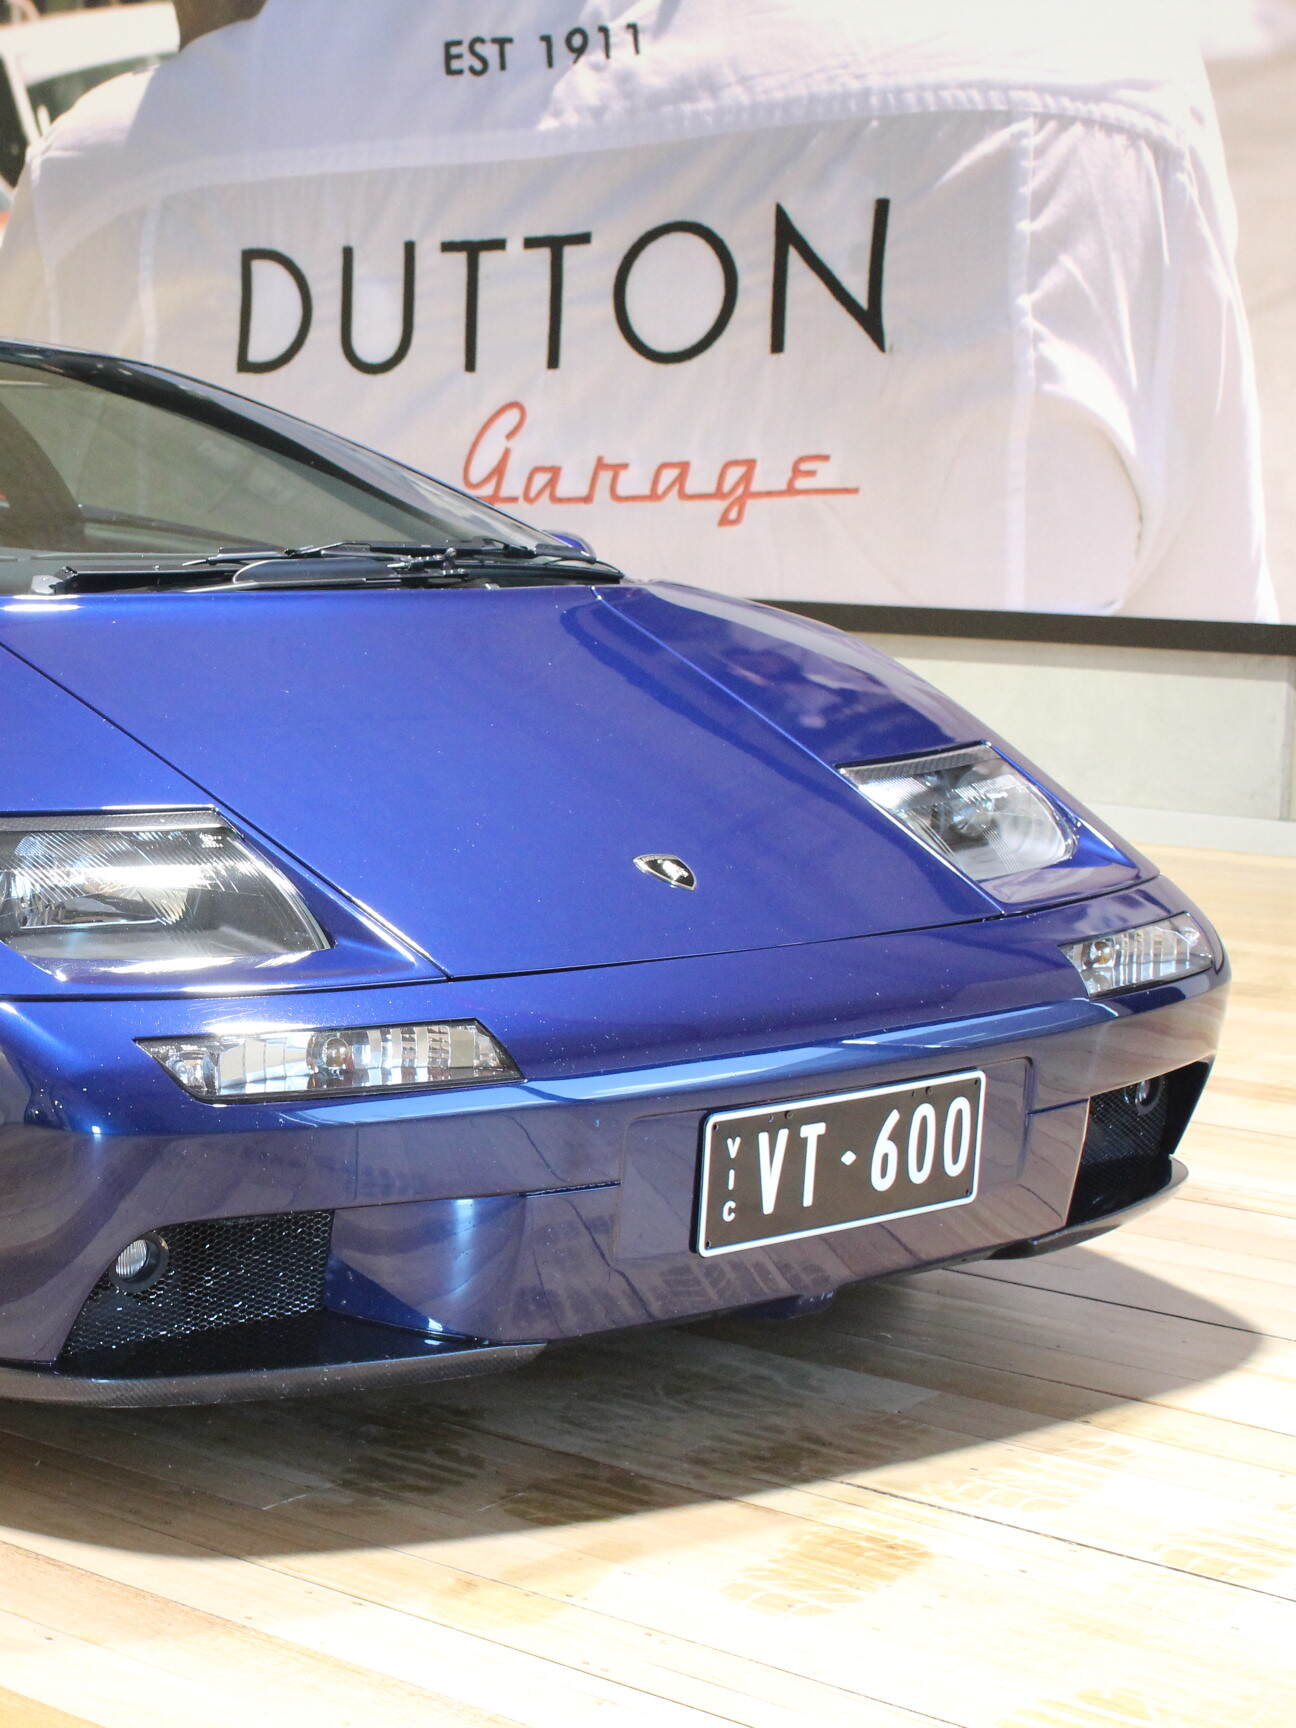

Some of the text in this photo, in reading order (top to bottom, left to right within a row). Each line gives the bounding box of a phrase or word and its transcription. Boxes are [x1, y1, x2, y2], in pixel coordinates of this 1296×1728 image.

[444, 22, 640, 77] EST 1911
[236, 198, 890, 375] DUTTON
[462, 401, 860, 527] Garage
[721, 1136, 741, 1222] VIC
